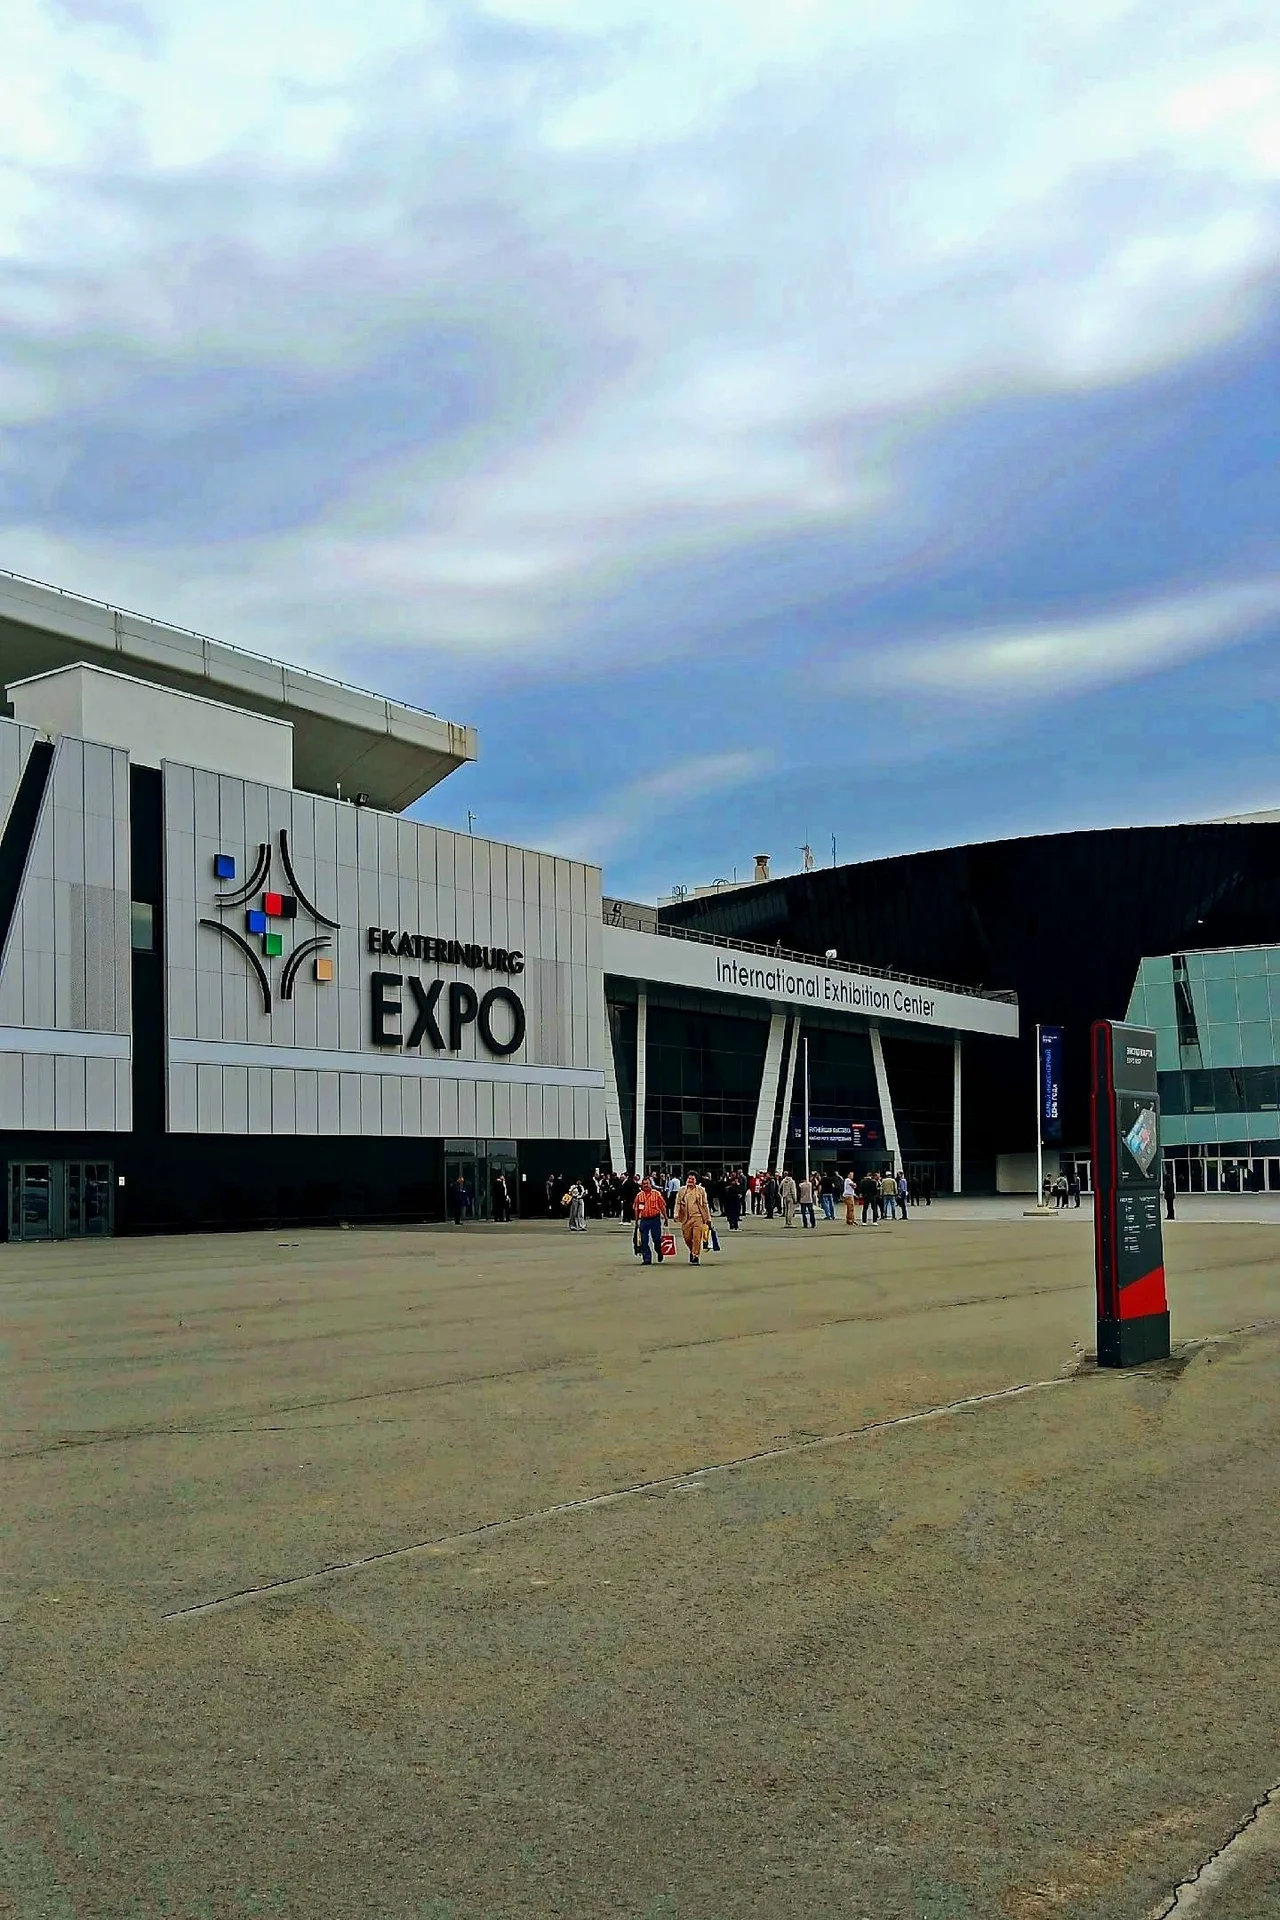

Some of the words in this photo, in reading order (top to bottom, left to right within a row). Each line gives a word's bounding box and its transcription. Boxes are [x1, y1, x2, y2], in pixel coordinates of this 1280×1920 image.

[368, 926, 525, 973] EKATERINBURG
[372, 971, 526, 1055] EXPO
[716, 956, 819, 998] International
[824, 977, 890, 1010] Exhibition
[893, 989, 935, 1017] Center
